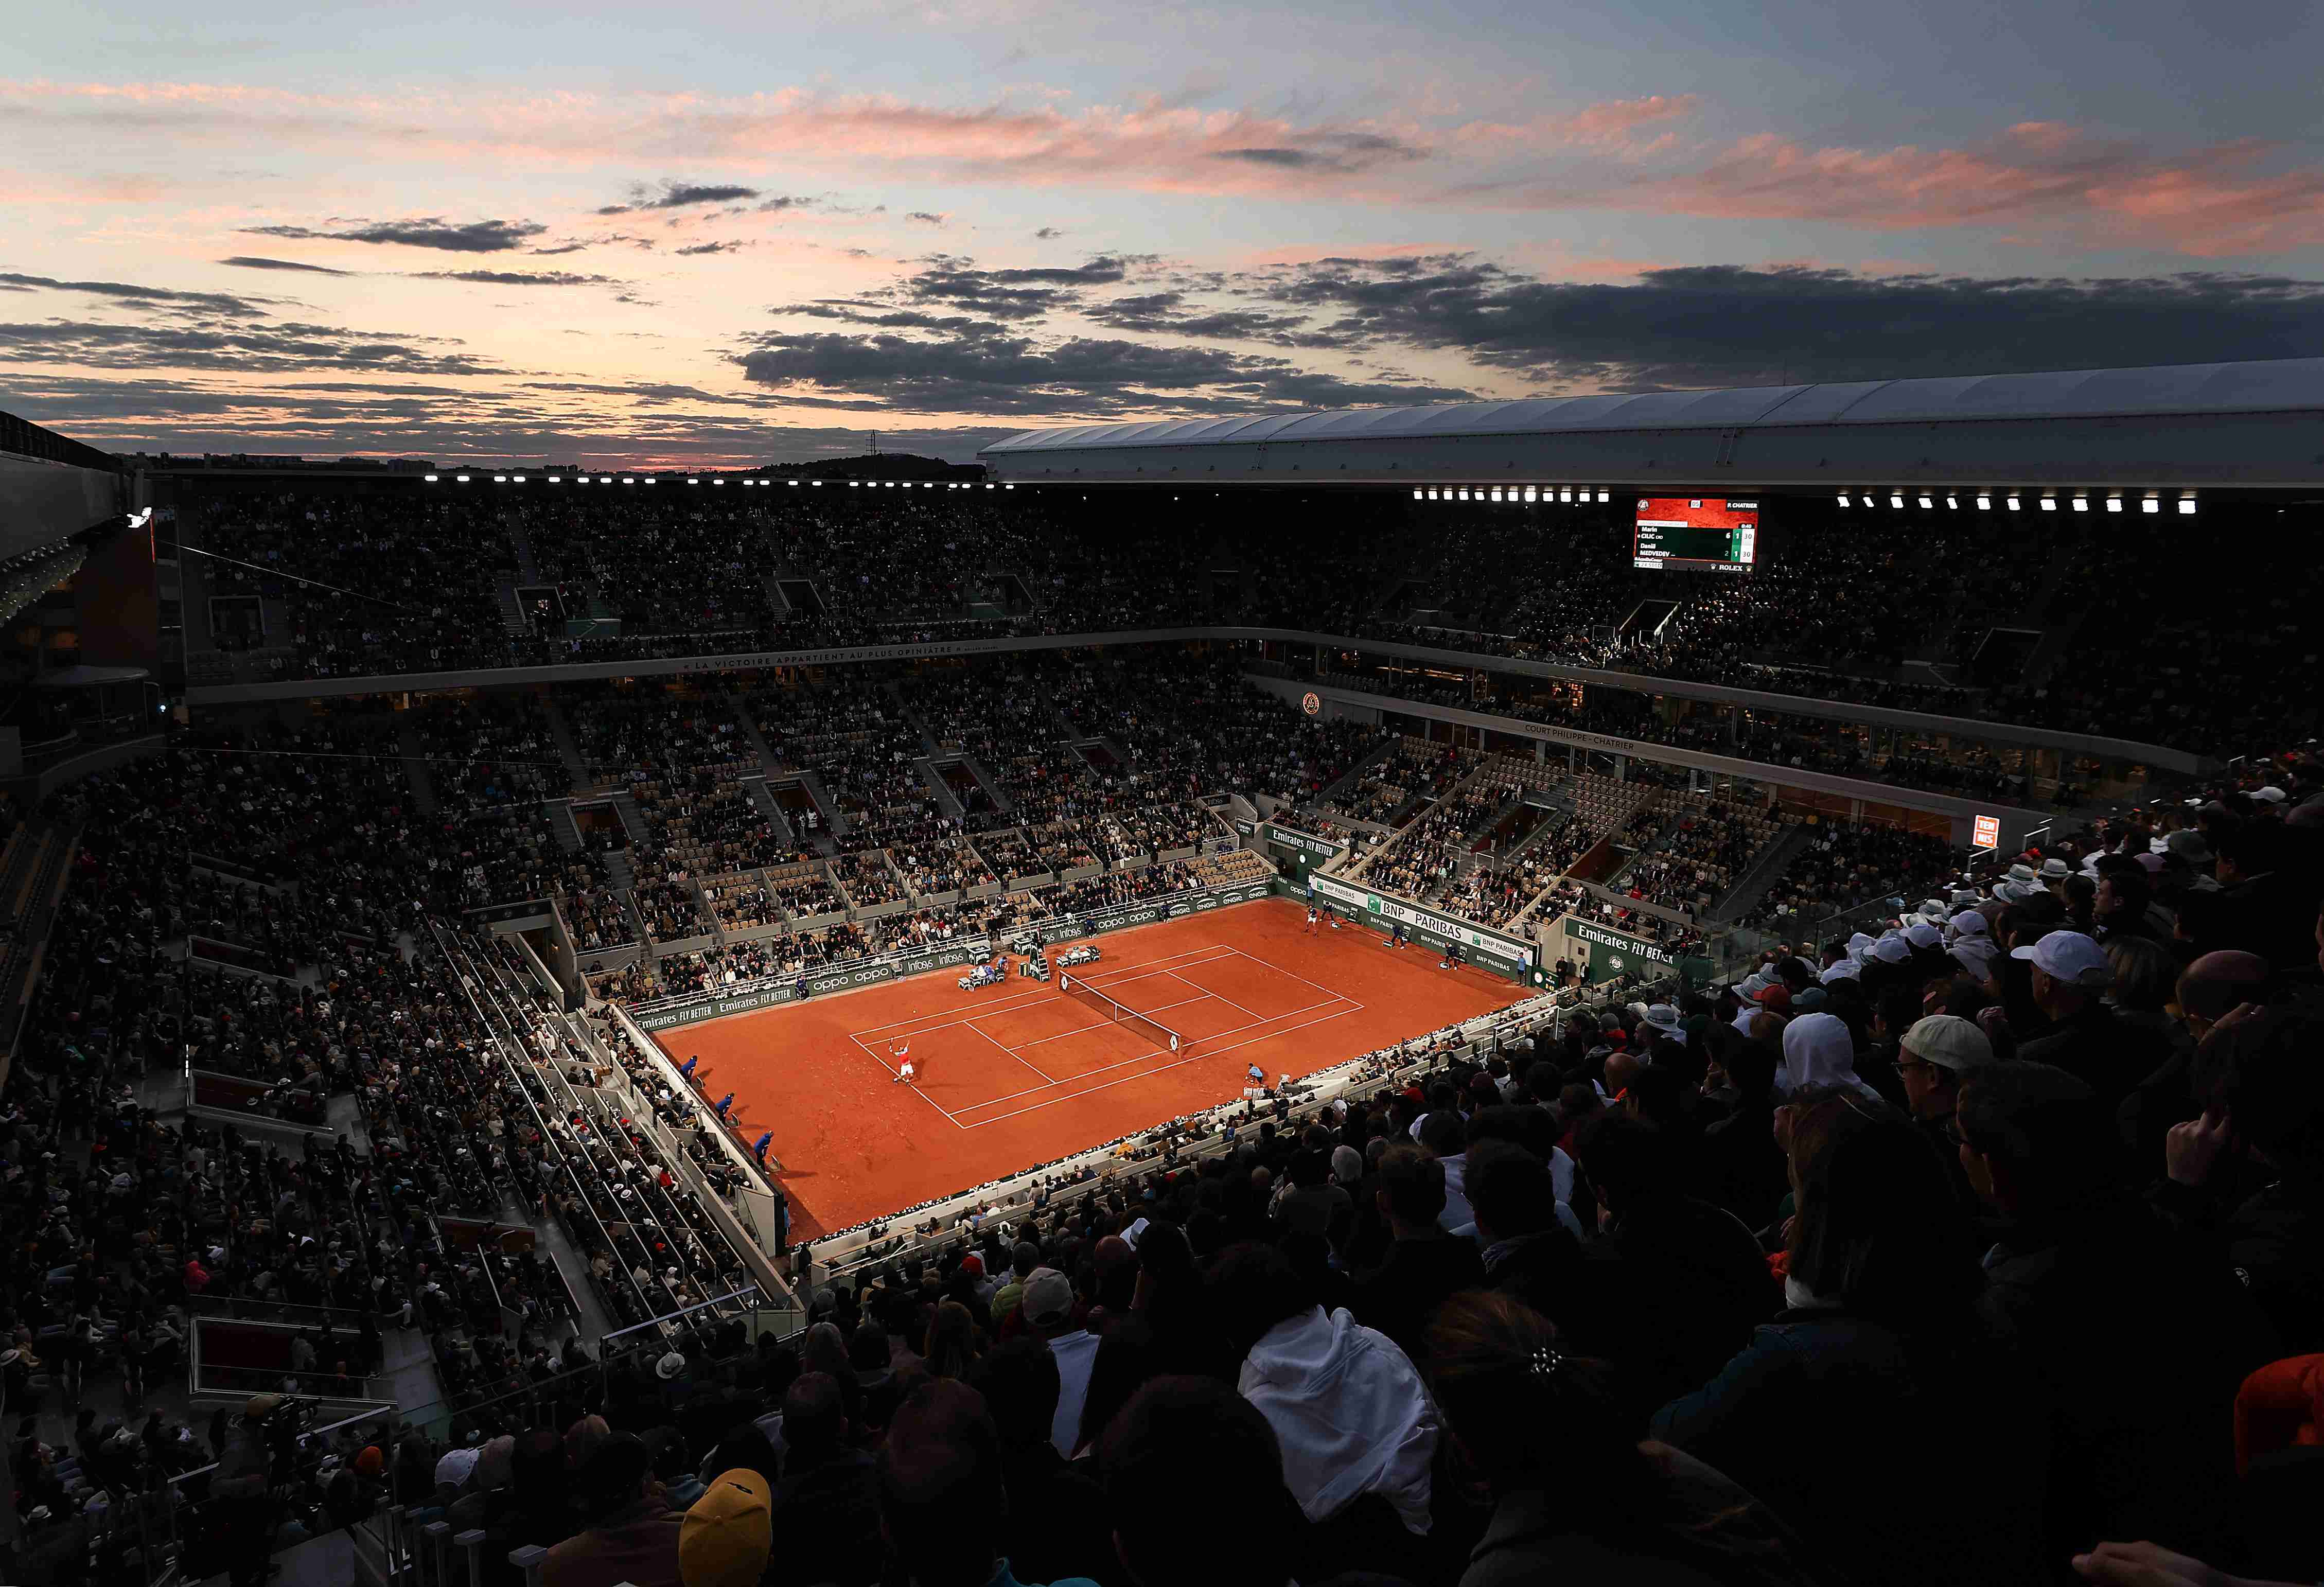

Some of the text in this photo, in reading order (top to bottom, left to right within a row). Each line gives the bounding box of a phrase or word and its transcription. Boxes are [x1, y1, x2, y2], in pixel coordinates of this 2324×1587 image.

[715, 658, 770, 668] VICTOIRE
[777, 653, 844, 664] APPARTIENT
[1525, 725, 1551, 735] COURT
[1553, 729, 1587, 742] PHILIPPE
[1594, 736, 1634, 750] CHATRIER
[1272, 829, 1333, 857] Emirates FLY BETTER
[1290, 886, 1307, 896] oppo
[1335, 888, 1355, 899] PARIBAS
[1098, 917, 1125, 929] oppo
[1129, 910, 1155, 923] oppo
[1370, 916, 1380, 925] BNP
[1383, 902, 1461, 939] BNP PARIBAS
[1059, 927, 1082, 939] Infosys
[1421, 934, 1432, 943] BNP
[1578, 924, 1628, 951] Emirates
[1631, 942, 1646, 956] FLY
[1482, 938, 1522, 956] BNP PARIBAS
[907, 959, 934, 972] Infosys
[938, 952, 964, 965] Infosys
[1476, 955, 1511, 972] BNP PARIBAS
[855, 967, 889, 982] oppo
[813, 976, 849, 992] oppo
[719, 989, 791, 1012] Emirates FLY BETTER
[637, 1006, 712, 1029] Emirates FLY BETTER
